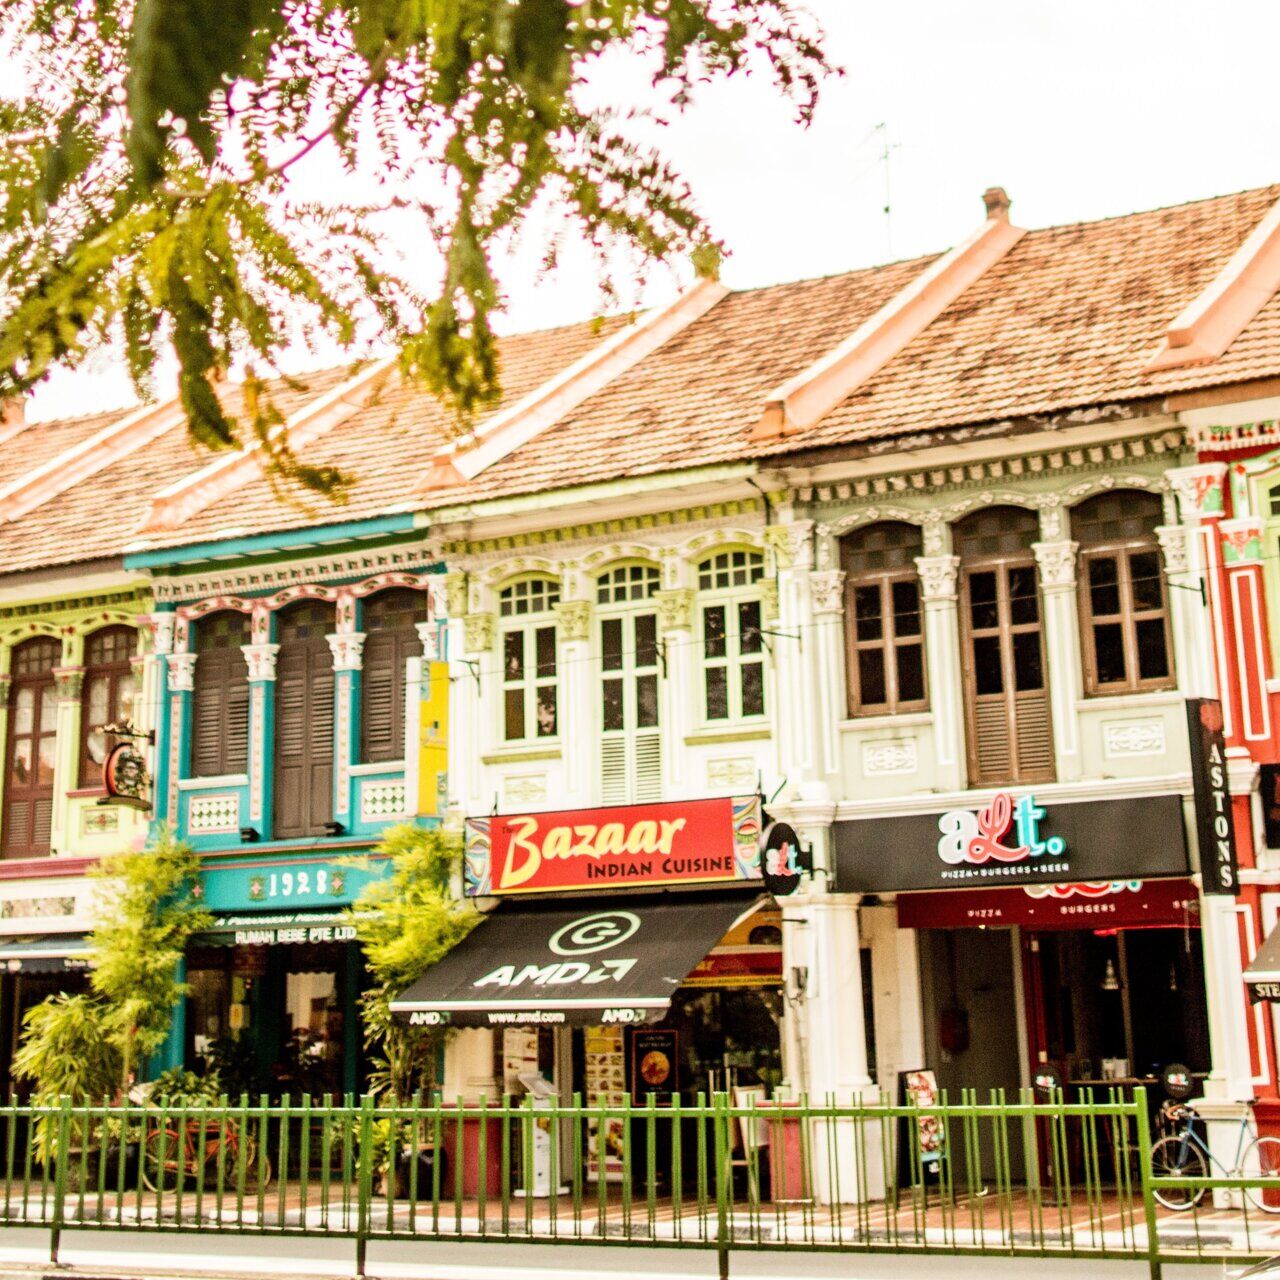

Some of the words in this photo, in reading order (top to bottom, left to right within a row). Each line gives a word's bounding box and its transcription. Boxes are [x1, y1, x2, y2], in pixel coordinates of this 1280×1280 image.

[1209, 743, 1233, 888] ASTONS
[500, 816, 687, 889] Bazaar
[587, 861, 652, 878] INDIAN
[662, 856, 733, 874] CUISINE
[941, 869, 973, 879] PIZZA
[980, 865, 1031, 877] BURGERS
[269, 869, 327, 897] 1928
[236, 929, 274, 945] RUMAH
[310, 927, 332, 943] PTE
[334, 926, 358, 940] LTD
[473, 961, 591, 987] AMD
[410, 1011, 441, 1025] AMD
[488, 1011, 565, 1024] www.amd.com
[602, 1009, 635, 1023] AMD
